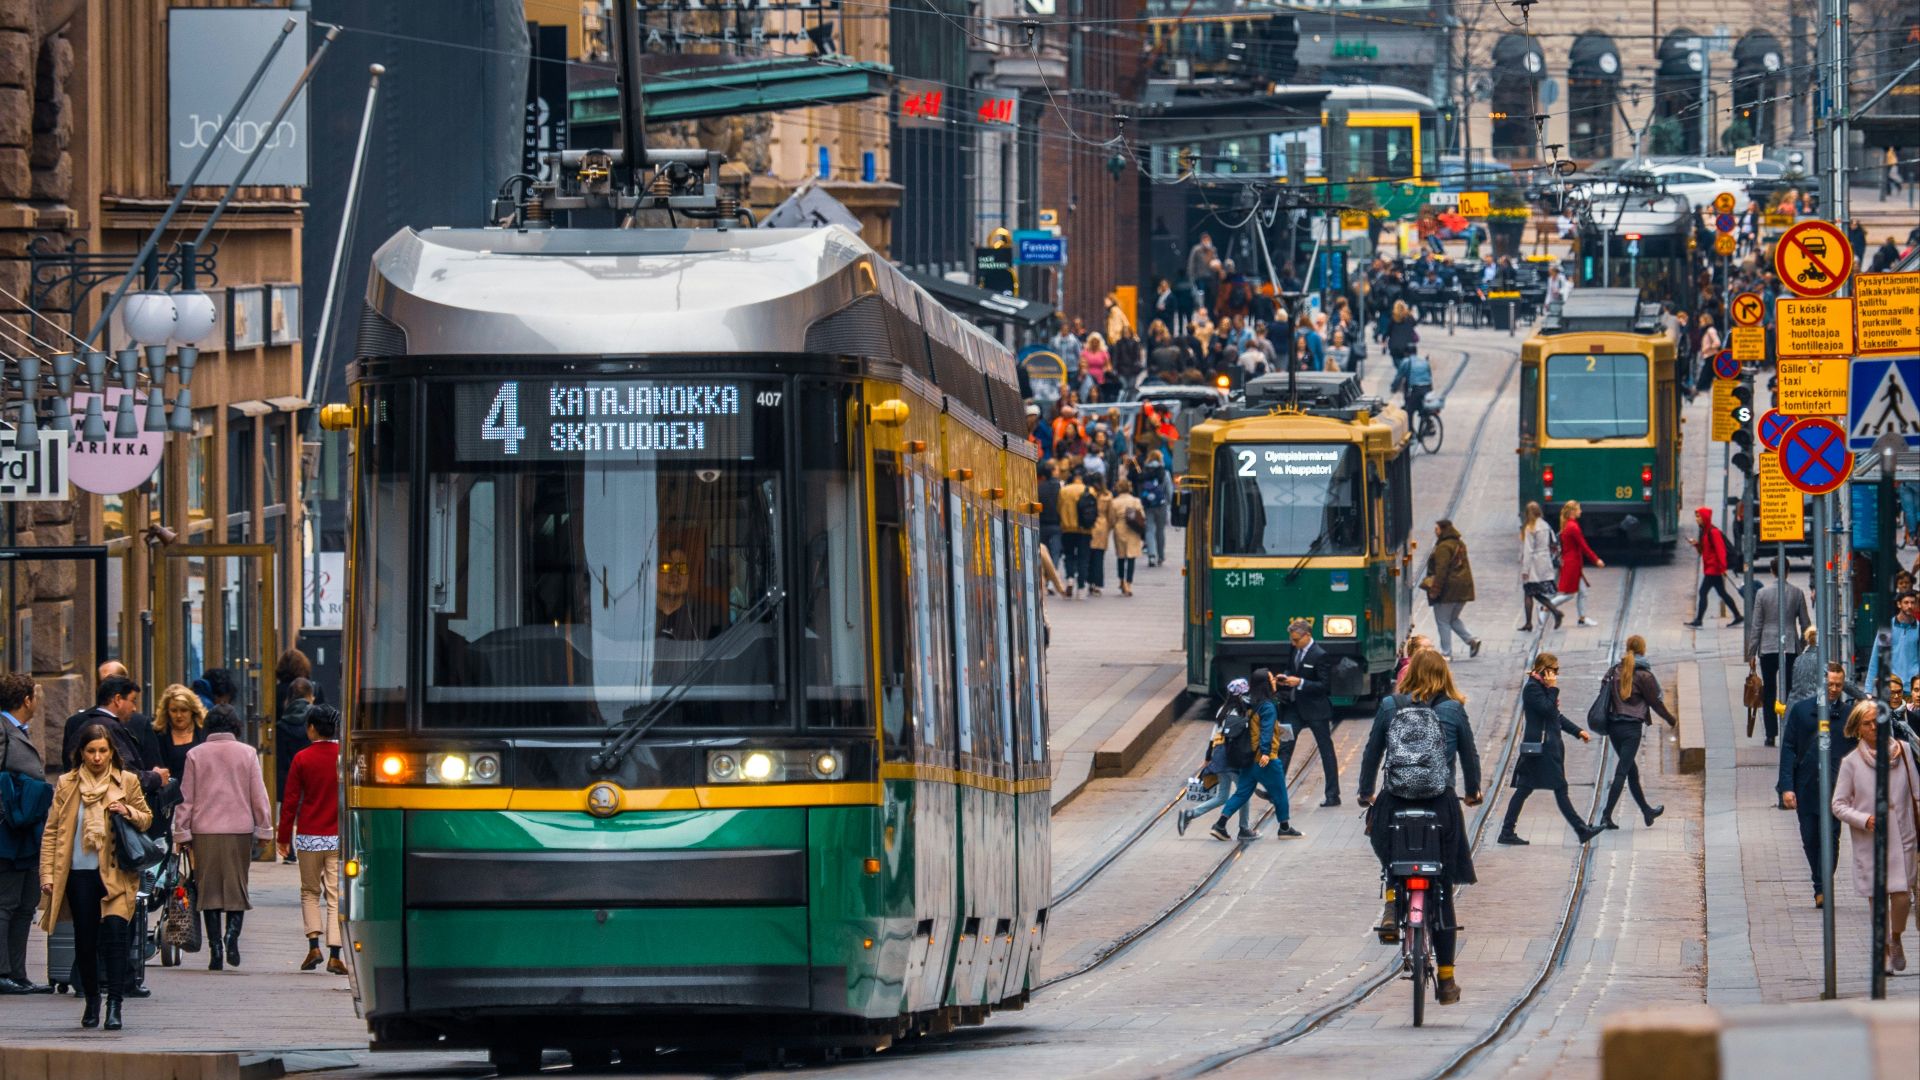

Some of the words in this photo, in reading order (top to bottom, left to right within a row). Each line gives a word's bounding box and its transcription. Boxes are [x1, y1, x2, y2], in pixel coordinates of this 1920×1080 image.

[1787, 304, 1796, 314] Ei
[1800, 304, 1827, 313] koske
[1859, 298, 1887, 307] sallittu
[1862, 318, 1902, 328] purkaville
[1585, 356, 1597, 372] 2
[1780, 363, 1806, 373] Gäller
[1811, 364, 1820, 374] ej
[757, 392, 782, 407] 407
[481, 381, 525, 454] 4
[549, 385, 739, 415] KATAJANOKKA
[1738, 407, 1751, 422] S
[549, 421, 705, 451] SKATUDDEN
[68, 442, 148, 456] ARIKKA
[1238, 450, 1257, 477] 2
[1269, 464, 1283, 475] via
[1284, 464, 1332, 476] Kauppatori
[1615, 486, 1633, 499] 89
